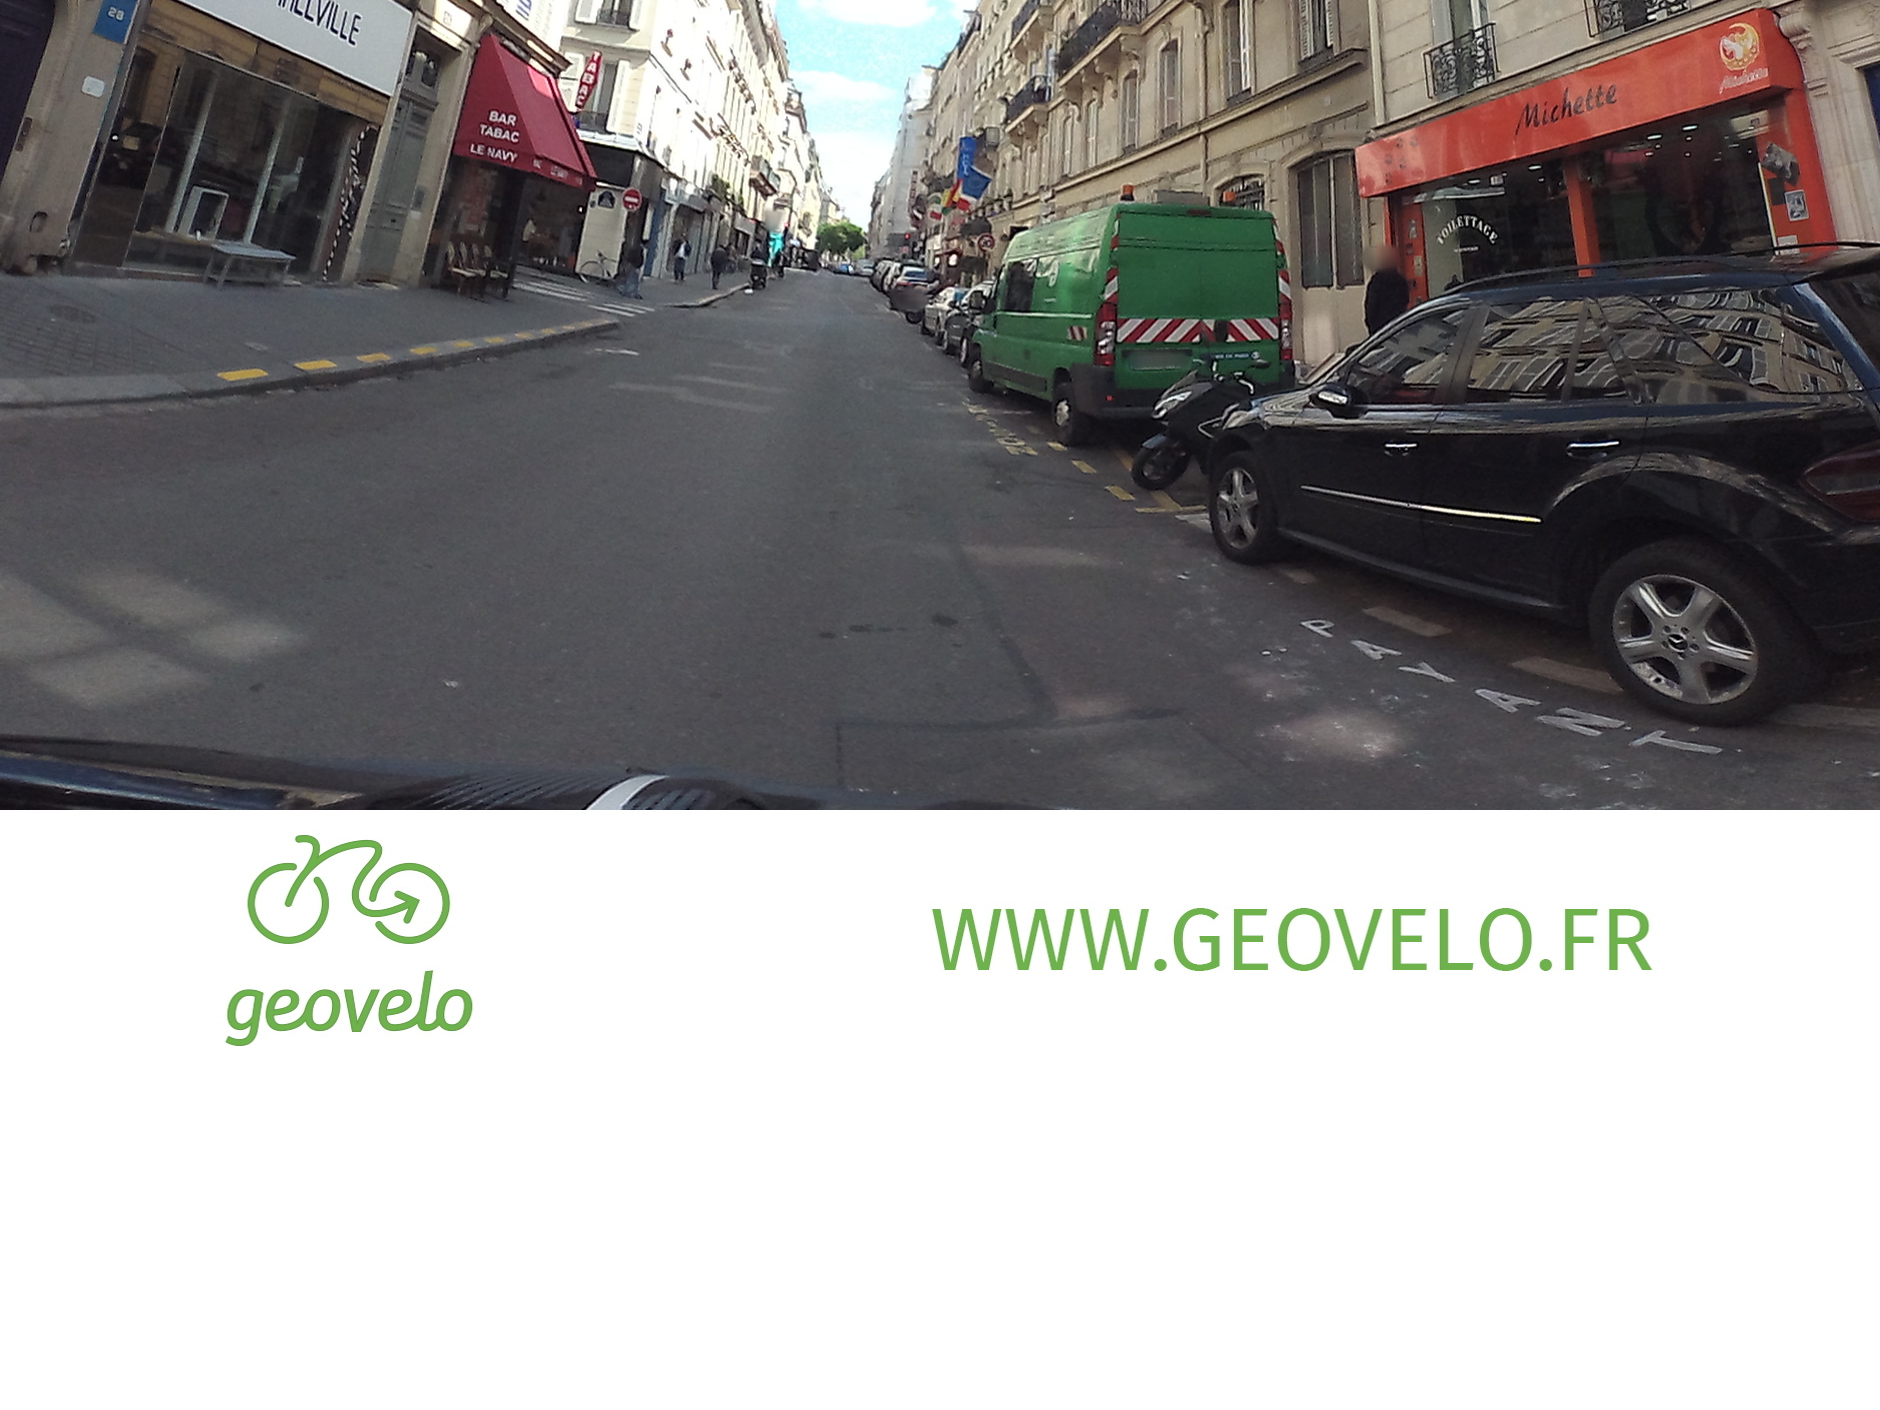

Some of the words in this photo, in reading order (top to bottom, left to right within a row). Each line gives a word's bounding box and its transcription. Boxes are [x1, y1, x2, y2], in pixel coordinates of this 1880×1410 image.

[107, 5, 125, 21] 28
[576, 50, 601, 108] TABAC
[488, 110, 518, 127] BAR
[1516, 83, 1618, 136] Michette
[478, 124, 521, 144] TABAC
[470, 142, 486, 156] LE
[487, 145, 519, 164] NAVY
[1436, 214, 1499, 245] TOILETTAGE
[1299, 618, 1724, 756] PAYANT
